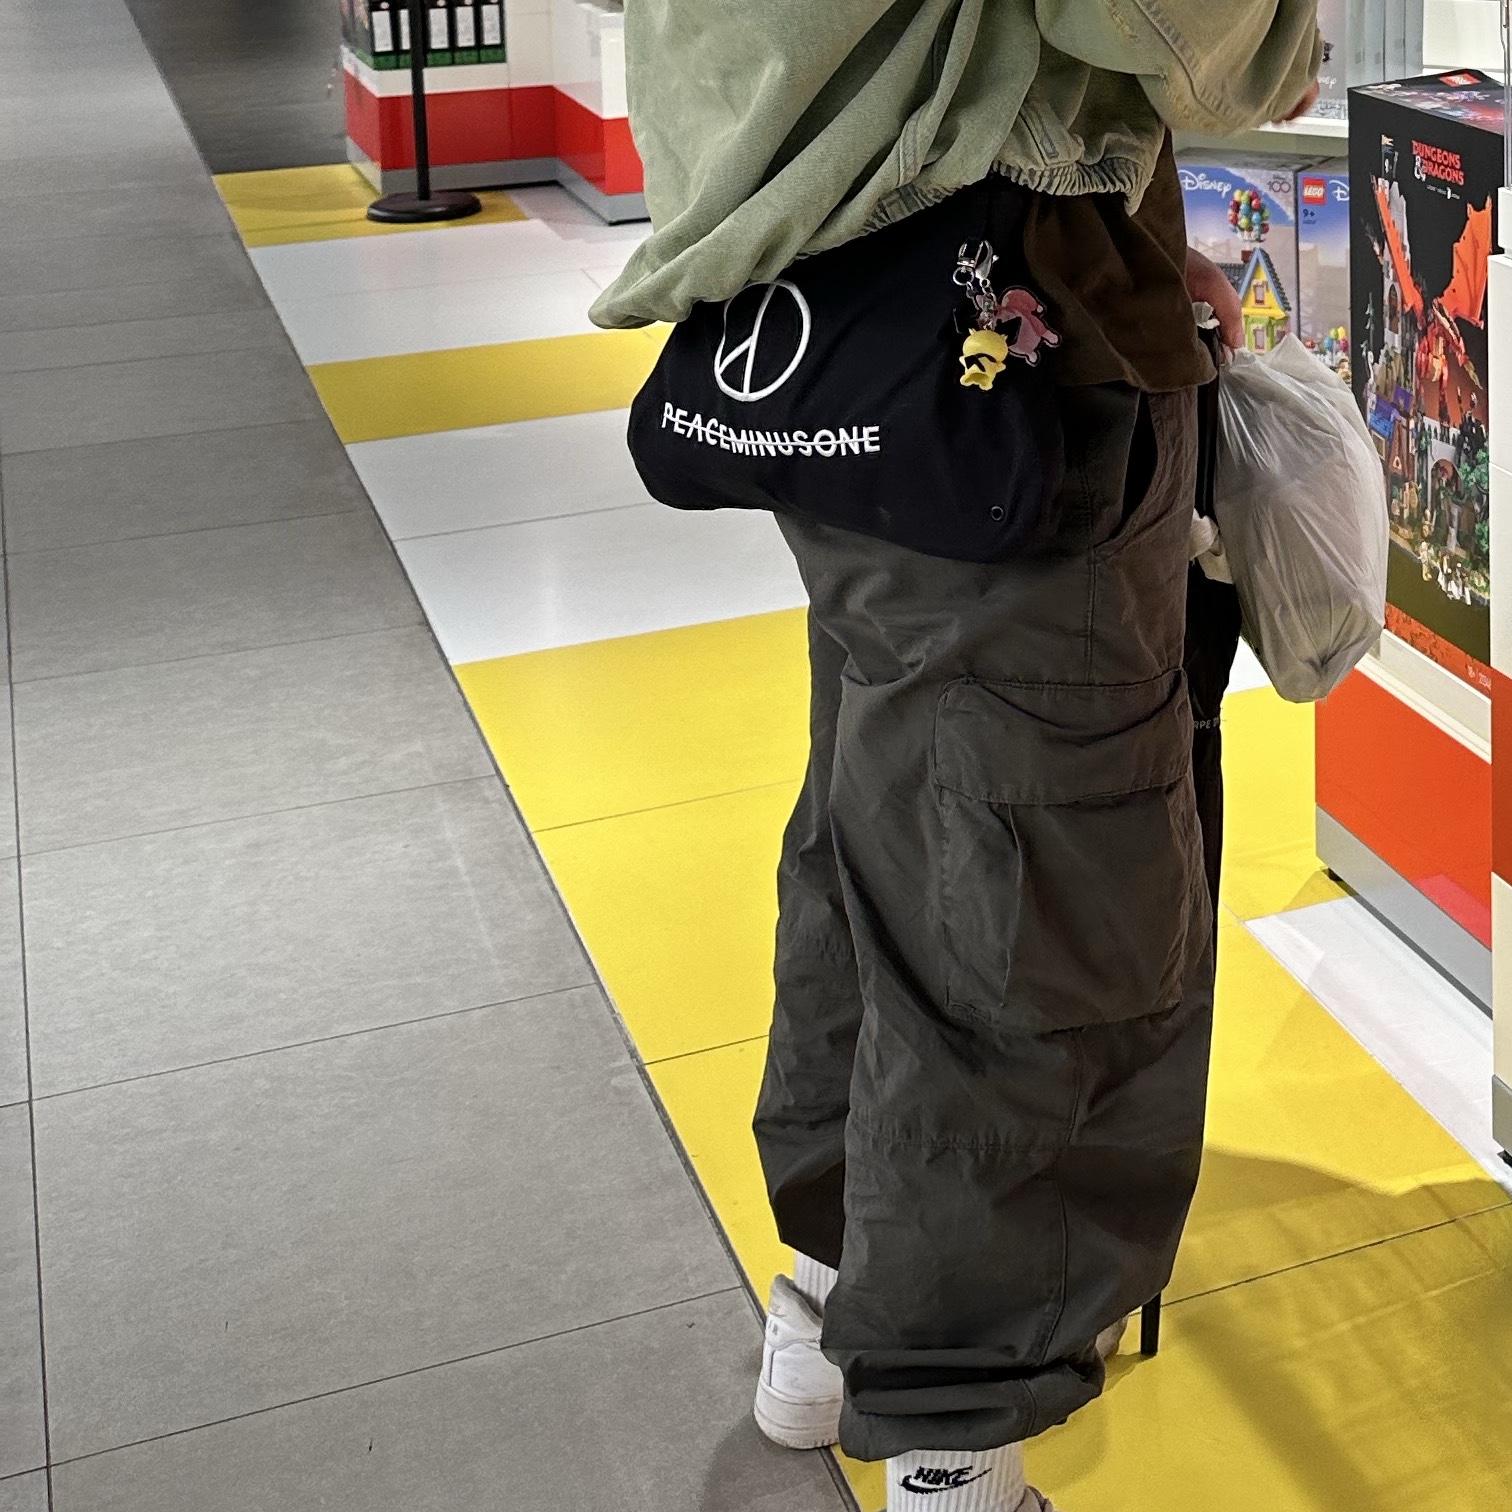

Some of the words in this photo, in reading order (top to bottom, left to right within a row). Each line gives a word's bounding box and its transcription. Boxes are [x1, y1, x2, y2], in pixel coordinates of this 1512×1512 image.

[1412, 139, 1461, 170] DUNGEONS
[1178, 169, 1232, 199] Disney
[1414, 155, 1427, 182] &
[1422, 158, 1465, 186] DRAGONS
[1303, 186, 1324, 197] LEGO
[661, 401, 881, 458] PEACEMINUSONE
[914, 1465, 974, 1487] NIKE
